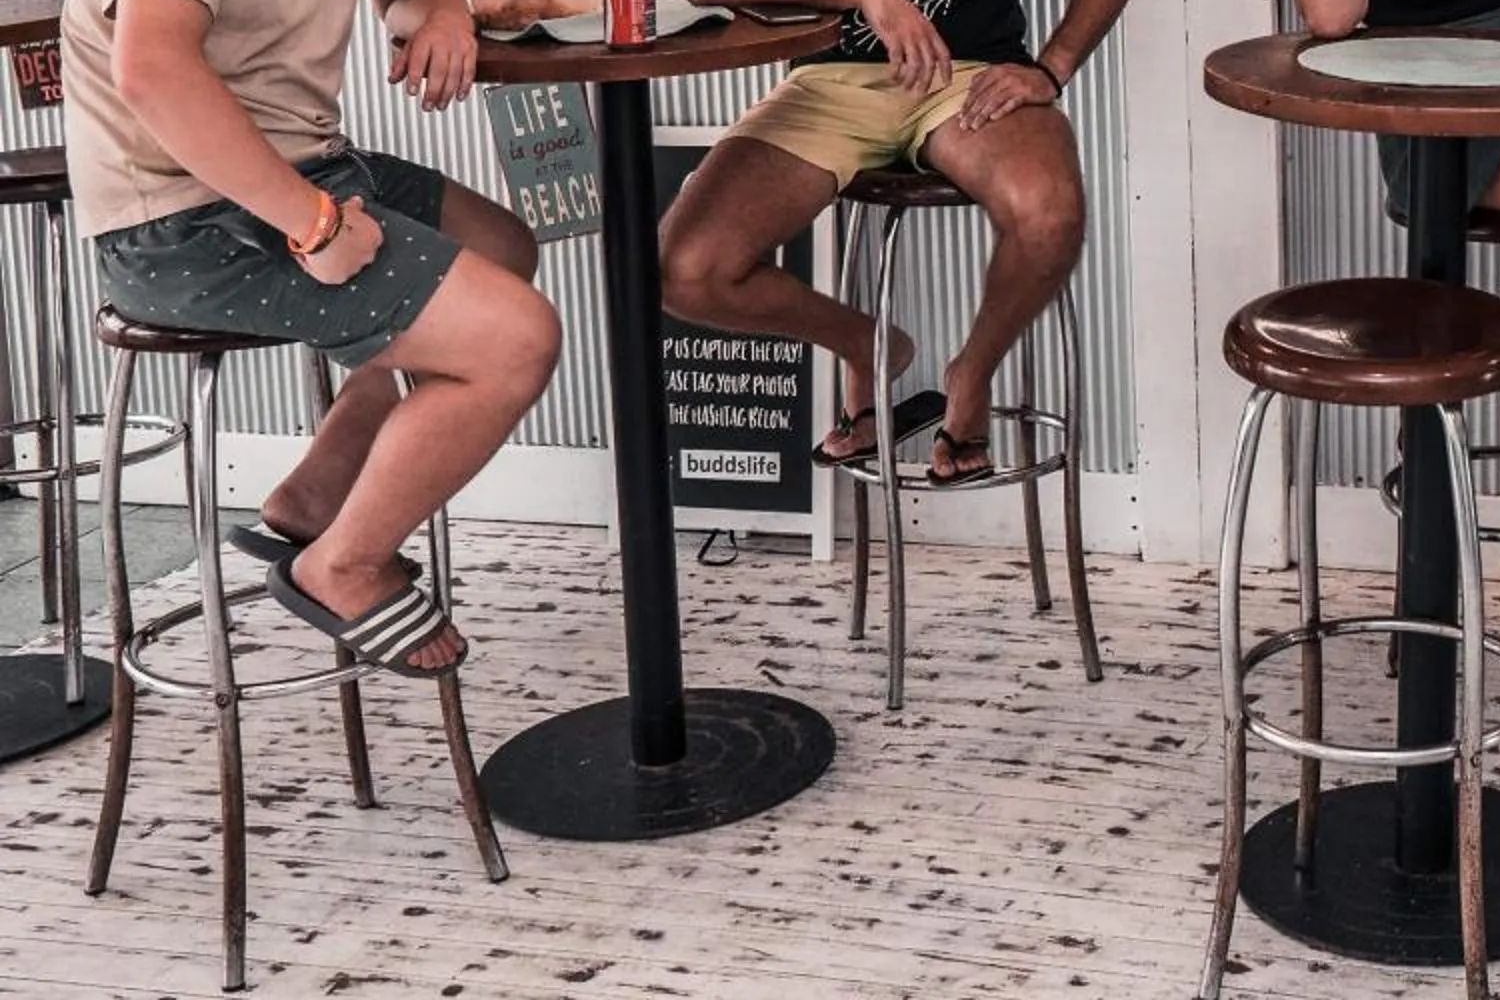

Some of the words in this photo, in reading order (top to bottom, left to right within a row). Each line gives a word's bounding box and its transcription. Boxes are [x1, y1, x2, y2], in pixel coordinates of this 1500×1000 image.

[17, 50, 62, 87] DEC
[504, 83, 570, 137] LIFE
[509, 138, 525, 161] is
[532, 127, 586, 160] good
[518, 172, 602, 230] BEACH
[675, 338, 690, 360] US
[692, 338, 749, 362] CAPTURE
[751, 340, 772, 363] THE
[773, 341, 804, 364] DAY!
[692, 370, 716, 393] TAG
[715, 372, 751, 394] YOUR
[752, 373, 799, 398] PHOTOS
[668, 402, 690, 426] THE
[686, 453, 778, 476] buddslife
